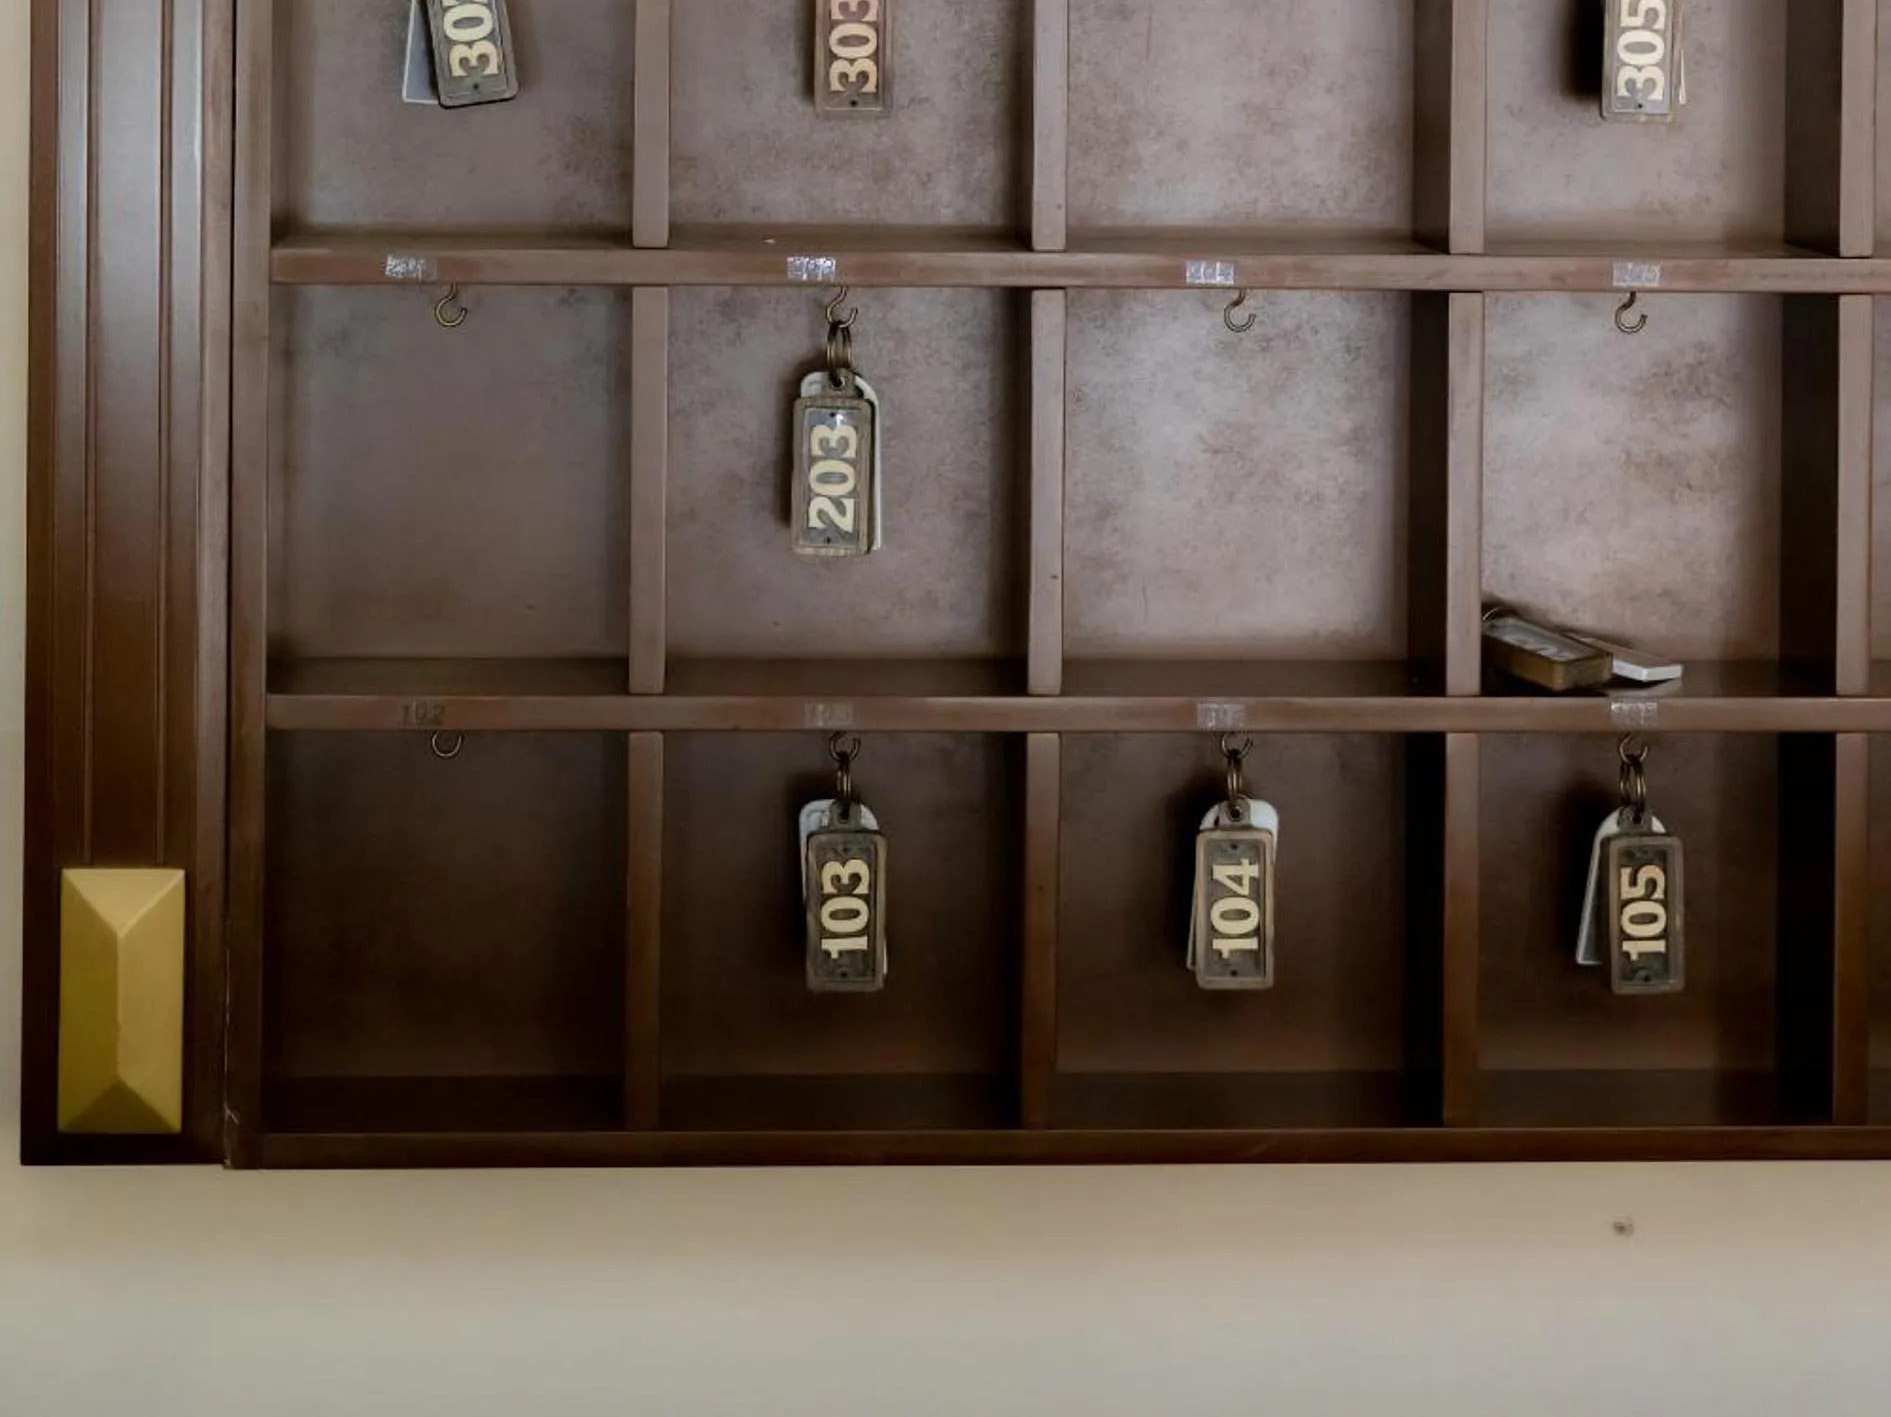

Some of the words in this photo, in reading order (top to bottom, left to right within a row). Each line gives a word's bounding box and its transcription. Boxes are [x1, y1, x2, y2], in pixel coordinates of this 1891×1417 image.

[808, 425, 857, 533] 203
[821, 859, 871, 958] 103
[1211, 857, 1260, 956] 104
[1621, 865, 1668, 961] 105
